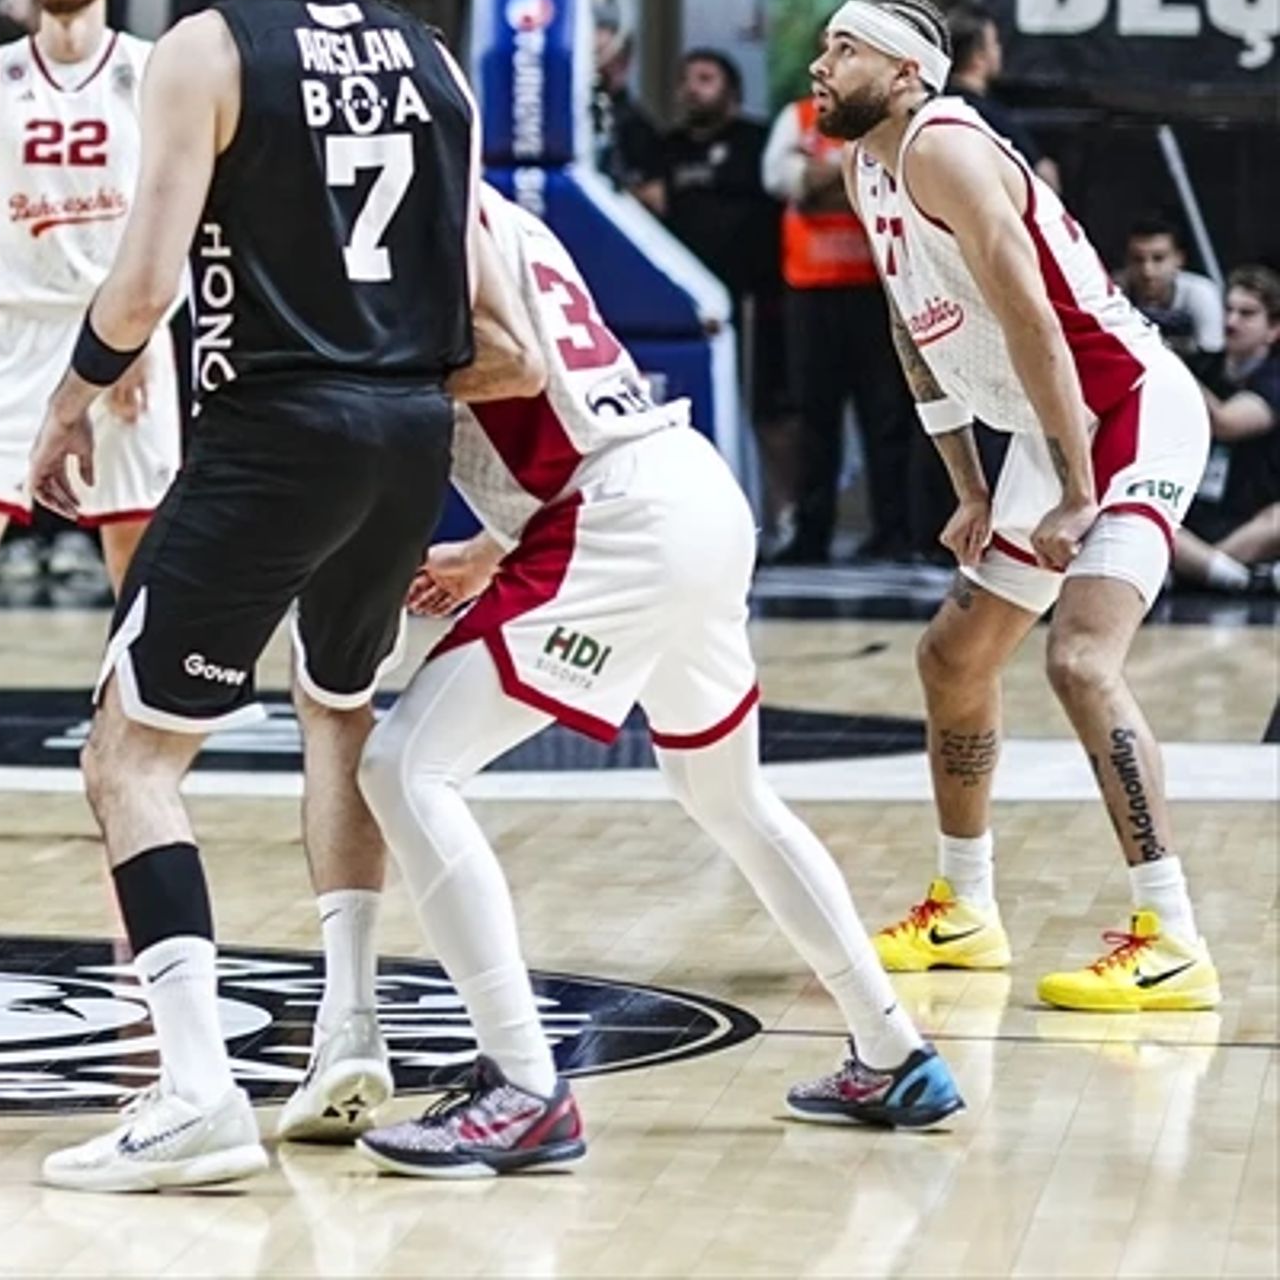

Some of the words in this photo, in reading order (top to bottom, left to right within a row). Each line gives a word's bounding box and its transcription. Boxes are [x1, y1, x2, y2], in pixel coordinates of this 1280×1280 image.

[295, 28, 416, 74] ARSLAN
[23, 119, 109, 166] 22
[325, 134, 415, 281] 7
[543, 625, 612, 676] HDI
